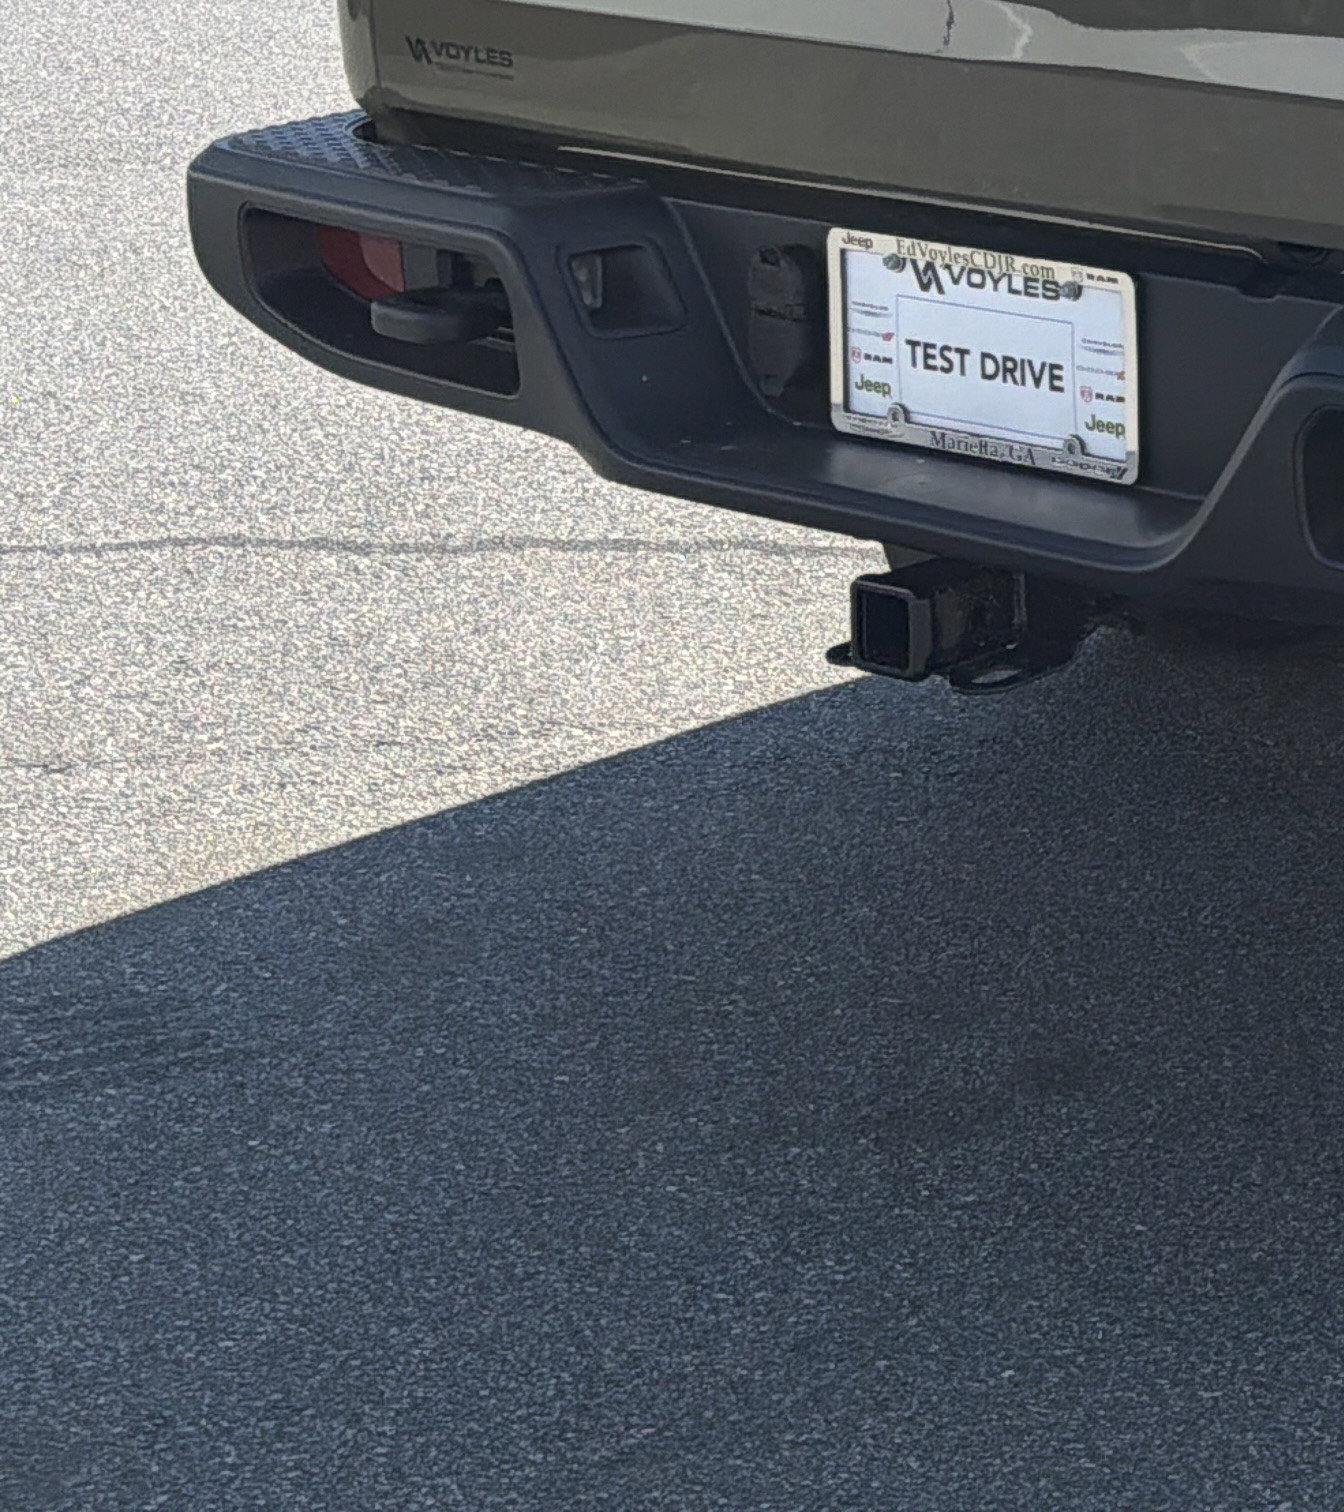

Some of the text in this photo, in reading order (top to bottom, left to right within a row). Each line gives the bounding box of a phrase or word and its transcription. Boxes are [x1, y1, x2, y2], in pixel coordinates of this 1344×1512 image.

[431, 41, 514, 68] VOYLES
[842, 232, 874, 249] Jeep
[944, 264, 1061, 301] VOYLES
[904, 338, 1065, 394] TEST DRIVE
[854, 373, 892, 399] Jeep
[1084, 413, 1126, 440] Jeep
[1008, 445, 1036, 467] GA
